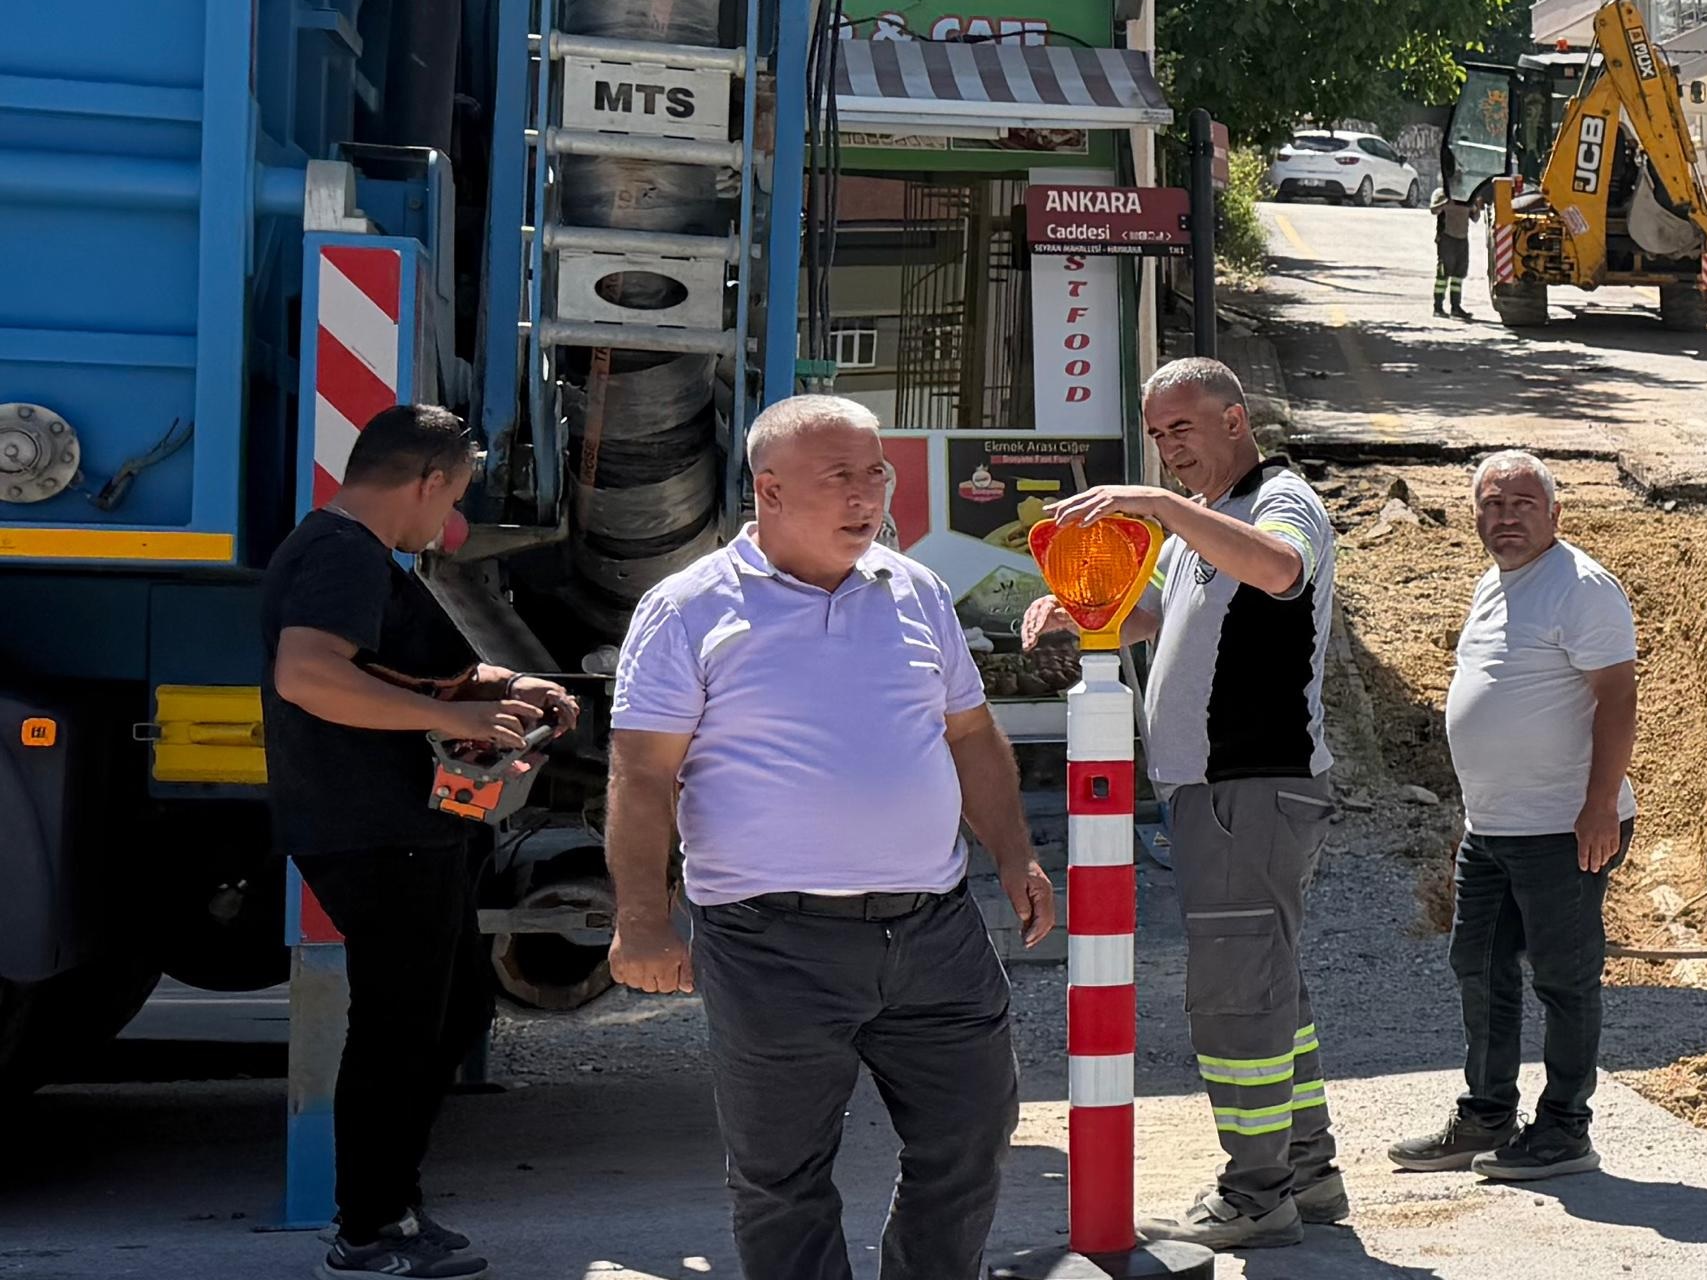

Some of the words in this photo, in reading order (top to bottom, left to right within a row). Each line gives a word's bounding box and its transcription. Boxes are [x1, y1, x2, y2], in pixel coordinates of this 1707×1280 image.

[593, 80, 696, 119] MTS
[1575, 116, 1606, 193] JCB
[1045, 190, 1142, 214] ANKARA
[1046, 223, 1110, 240] Caddesi
